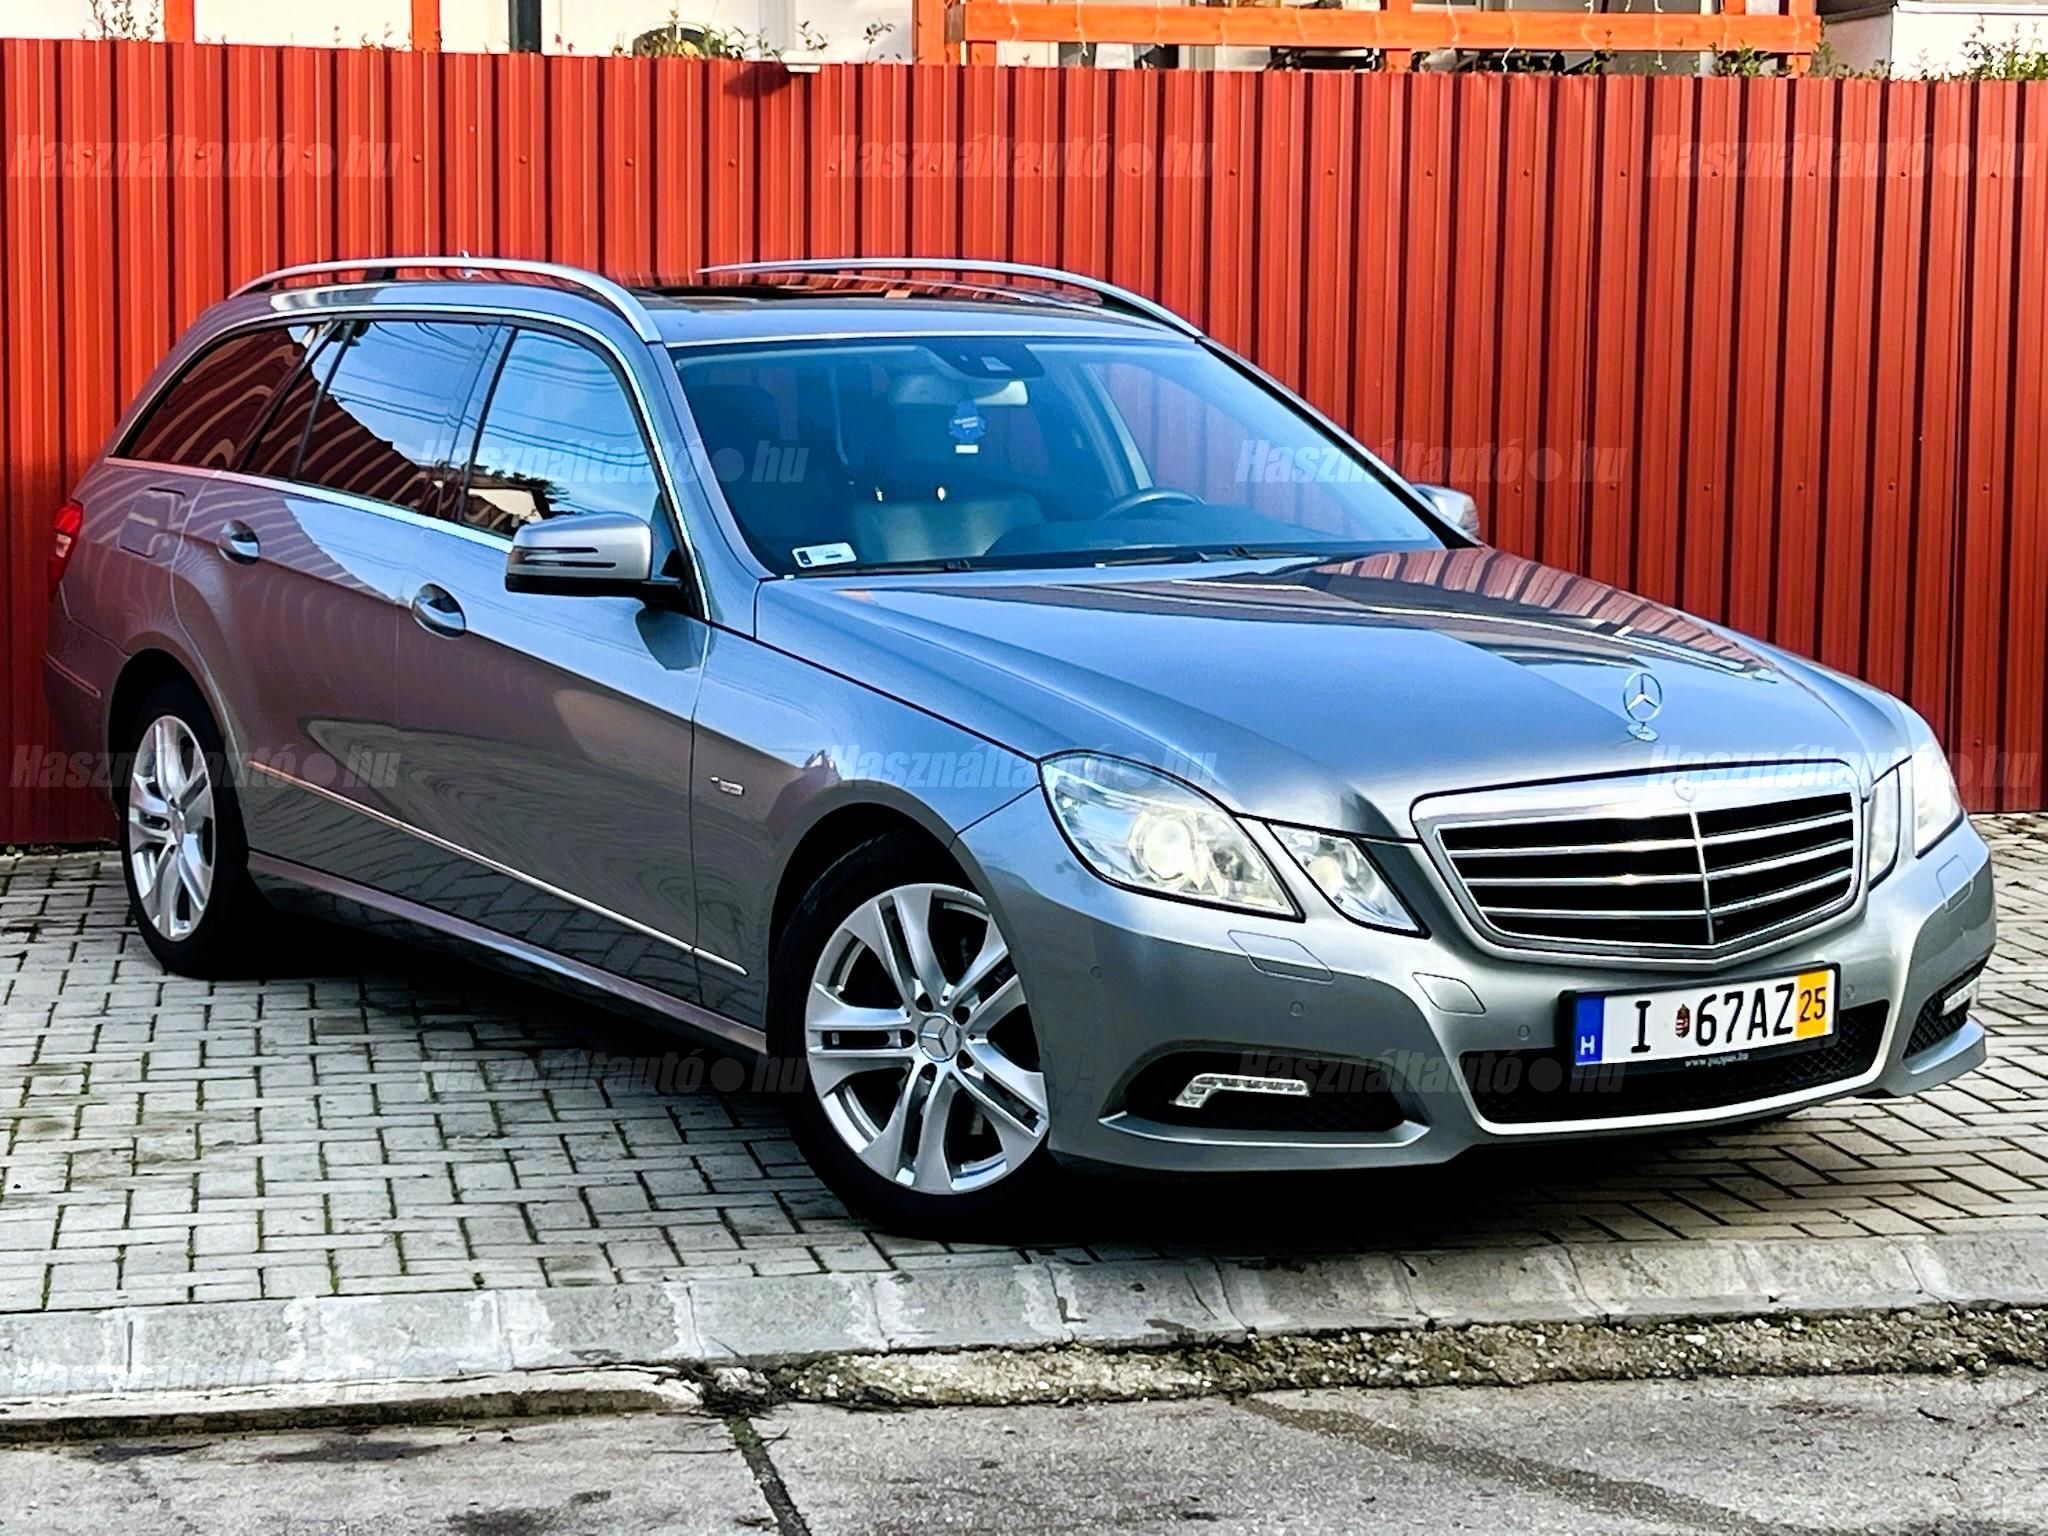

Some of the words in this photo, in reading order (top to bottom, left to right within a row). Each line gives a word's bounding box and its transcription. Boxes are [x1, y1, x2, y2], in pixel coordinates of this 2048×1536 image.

[1631, 1000, 1651, 1053] I
[1696, 983, 1795, 1046] 67AZ
[1799, 987, 1826, 1022] 25
[1580, 1035, 1595, 1055] H
